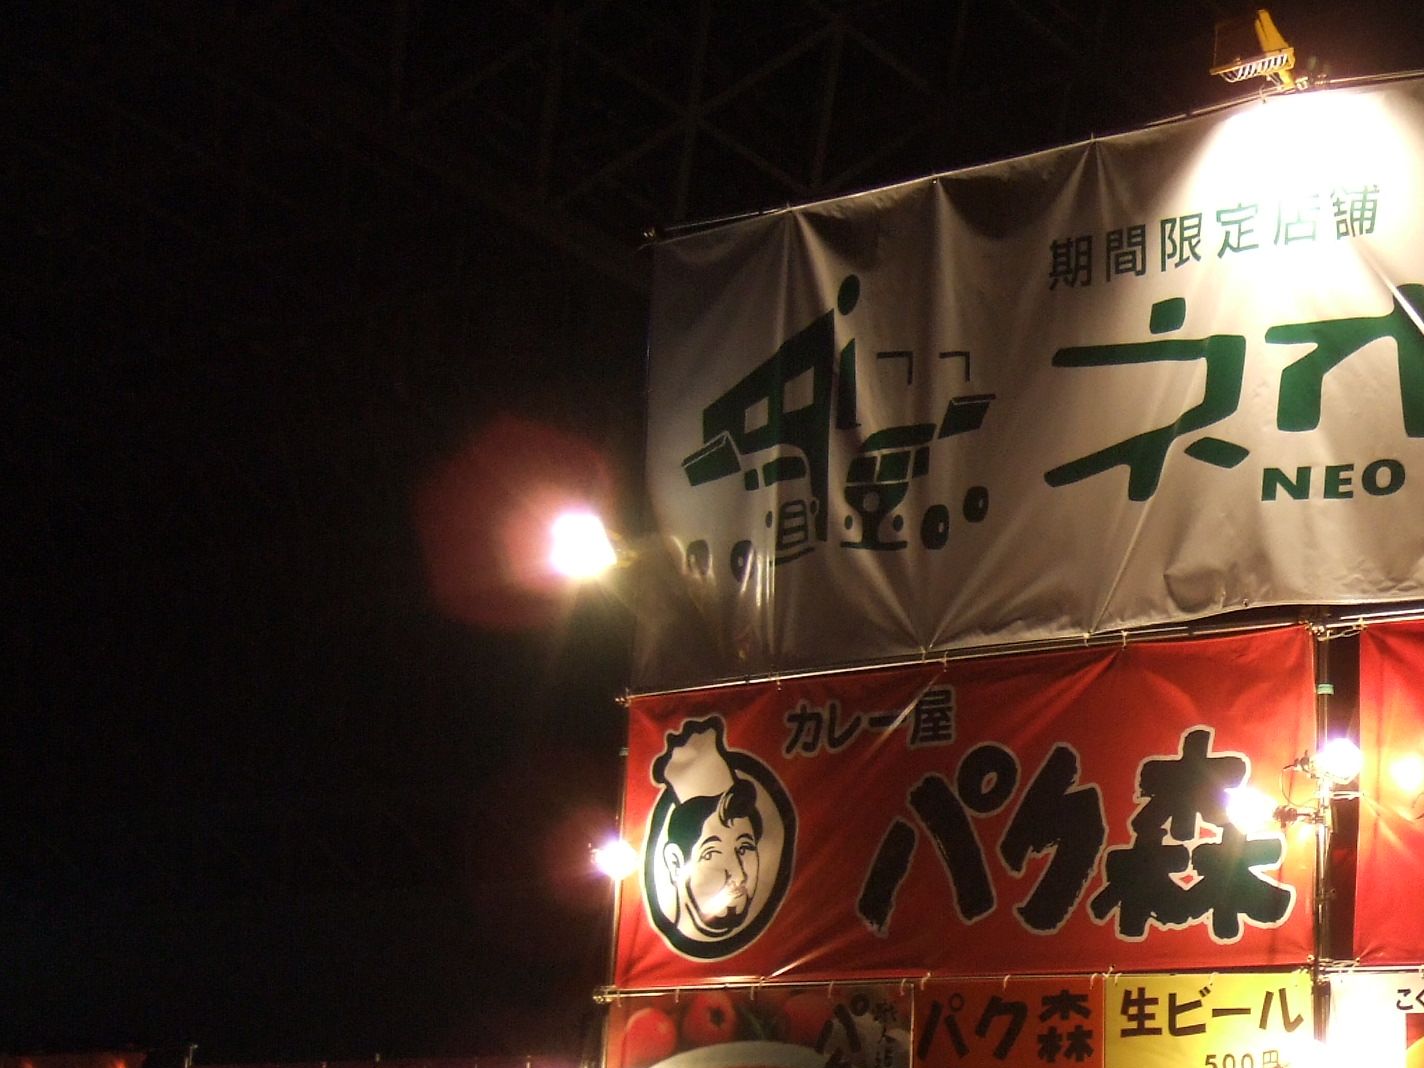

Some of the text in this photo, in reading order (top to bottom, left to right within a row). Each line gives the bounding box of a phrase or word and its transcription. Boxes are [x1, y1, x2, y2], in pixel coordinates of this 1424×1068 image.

[1048, 184, 1379, 290] 期間限定店舗
[1261, 459, 1406, 502] NEO
[785, 688, 956, 757] カレー屋
[857, 726, 1296, 946] パク森
[917, 989, 1095, 1063] パク森
[1120, 984, 1304, 1038] 生ビール
